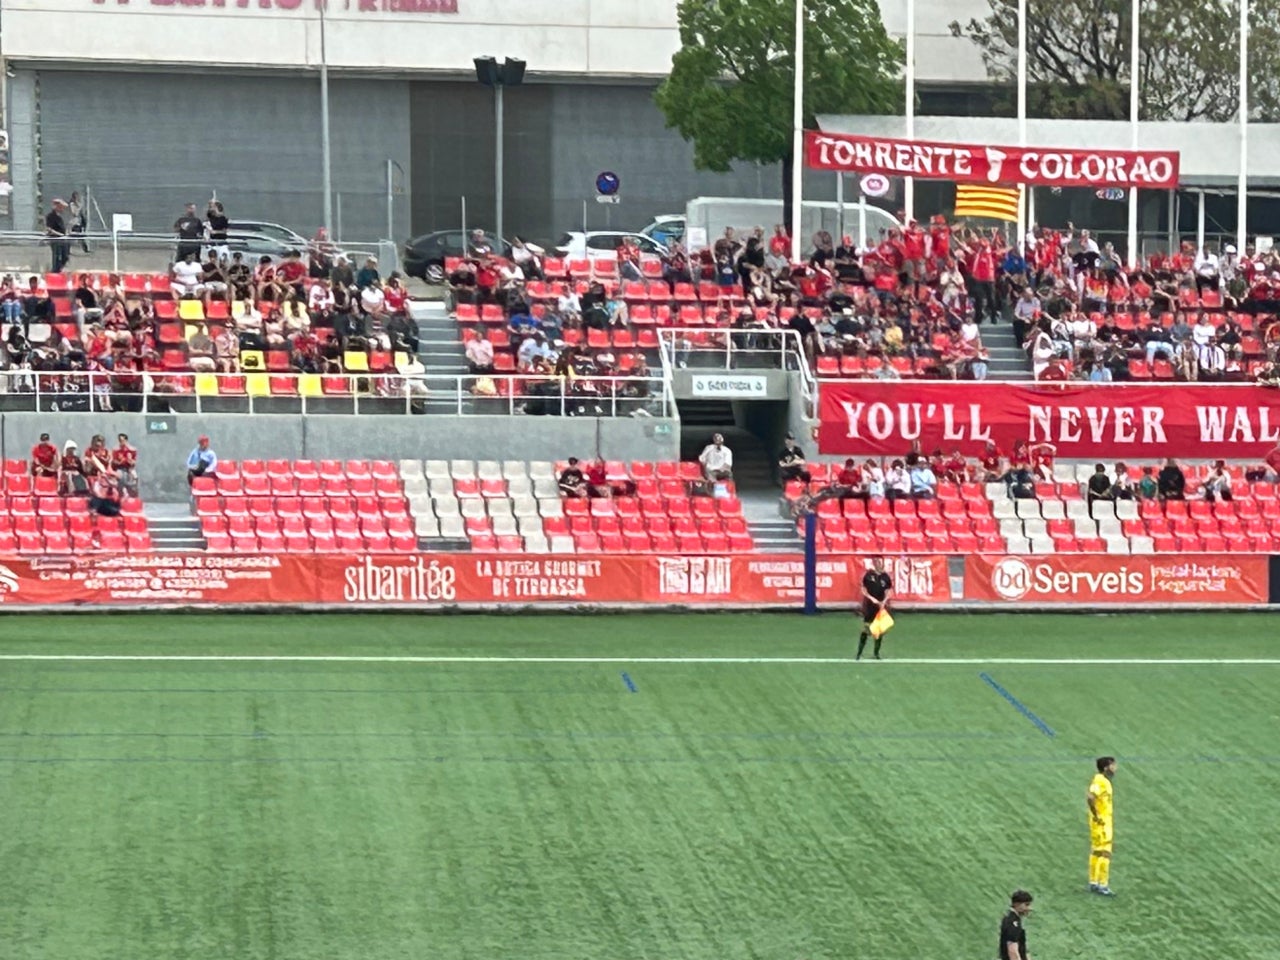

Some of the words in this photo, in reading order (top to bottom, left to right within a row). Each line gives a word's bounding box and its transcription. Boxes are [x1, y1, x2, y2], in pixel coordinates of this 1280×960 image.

[814, 137, 972, 175] TORRENTE
[1019, 152, 1173, 182] COLORAO
[841, 401, 991, 441] YOU'LL
[1028, 404, 1167, 443] NEVER
[476, 560, 493, 576] LA
[1034, 563, 1144, 594] Serveis
